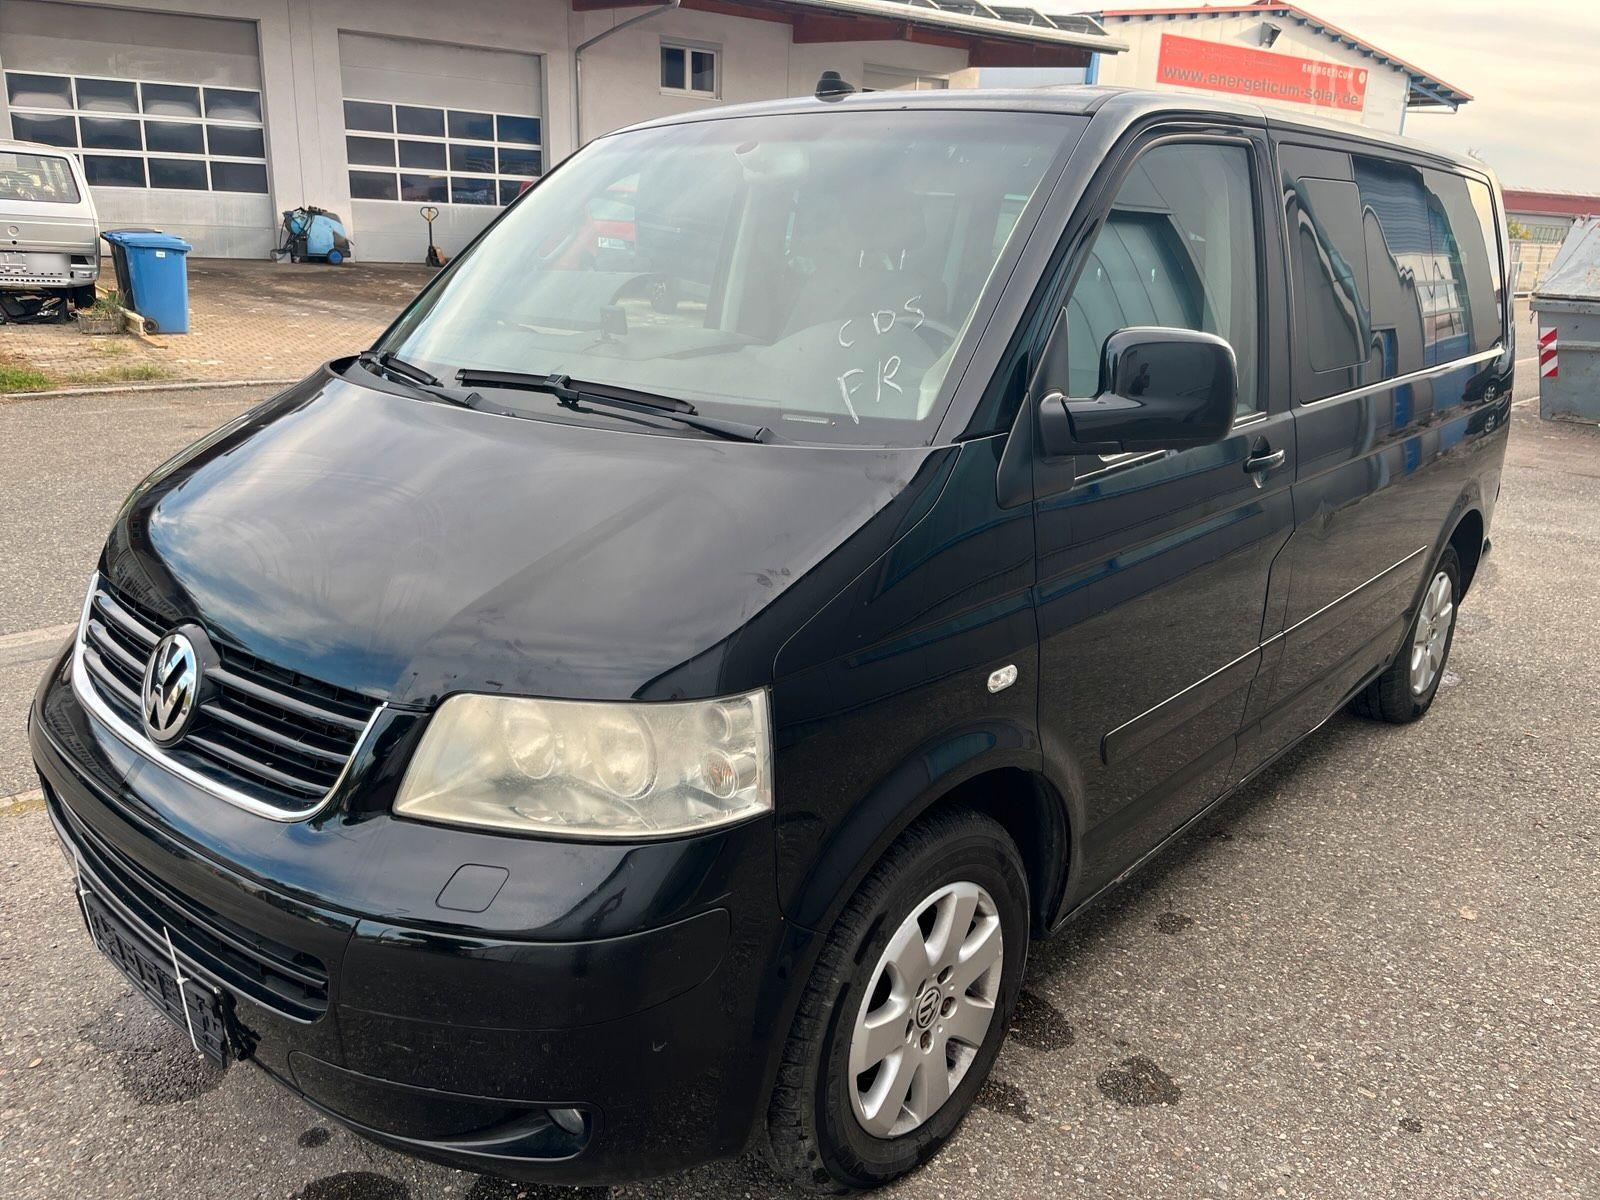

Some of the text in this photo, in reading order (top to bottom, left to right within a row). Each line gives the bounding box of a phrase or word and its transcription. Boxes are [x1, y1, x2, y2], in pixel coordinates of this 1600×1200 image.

[1163, 66, 1358, 105] www.energeticum-solar.de
[1301, 63, 1354, 80] ENERGETICUM
[837, 355, 903, 424] FR
[143, 634, 197, 741] VW
